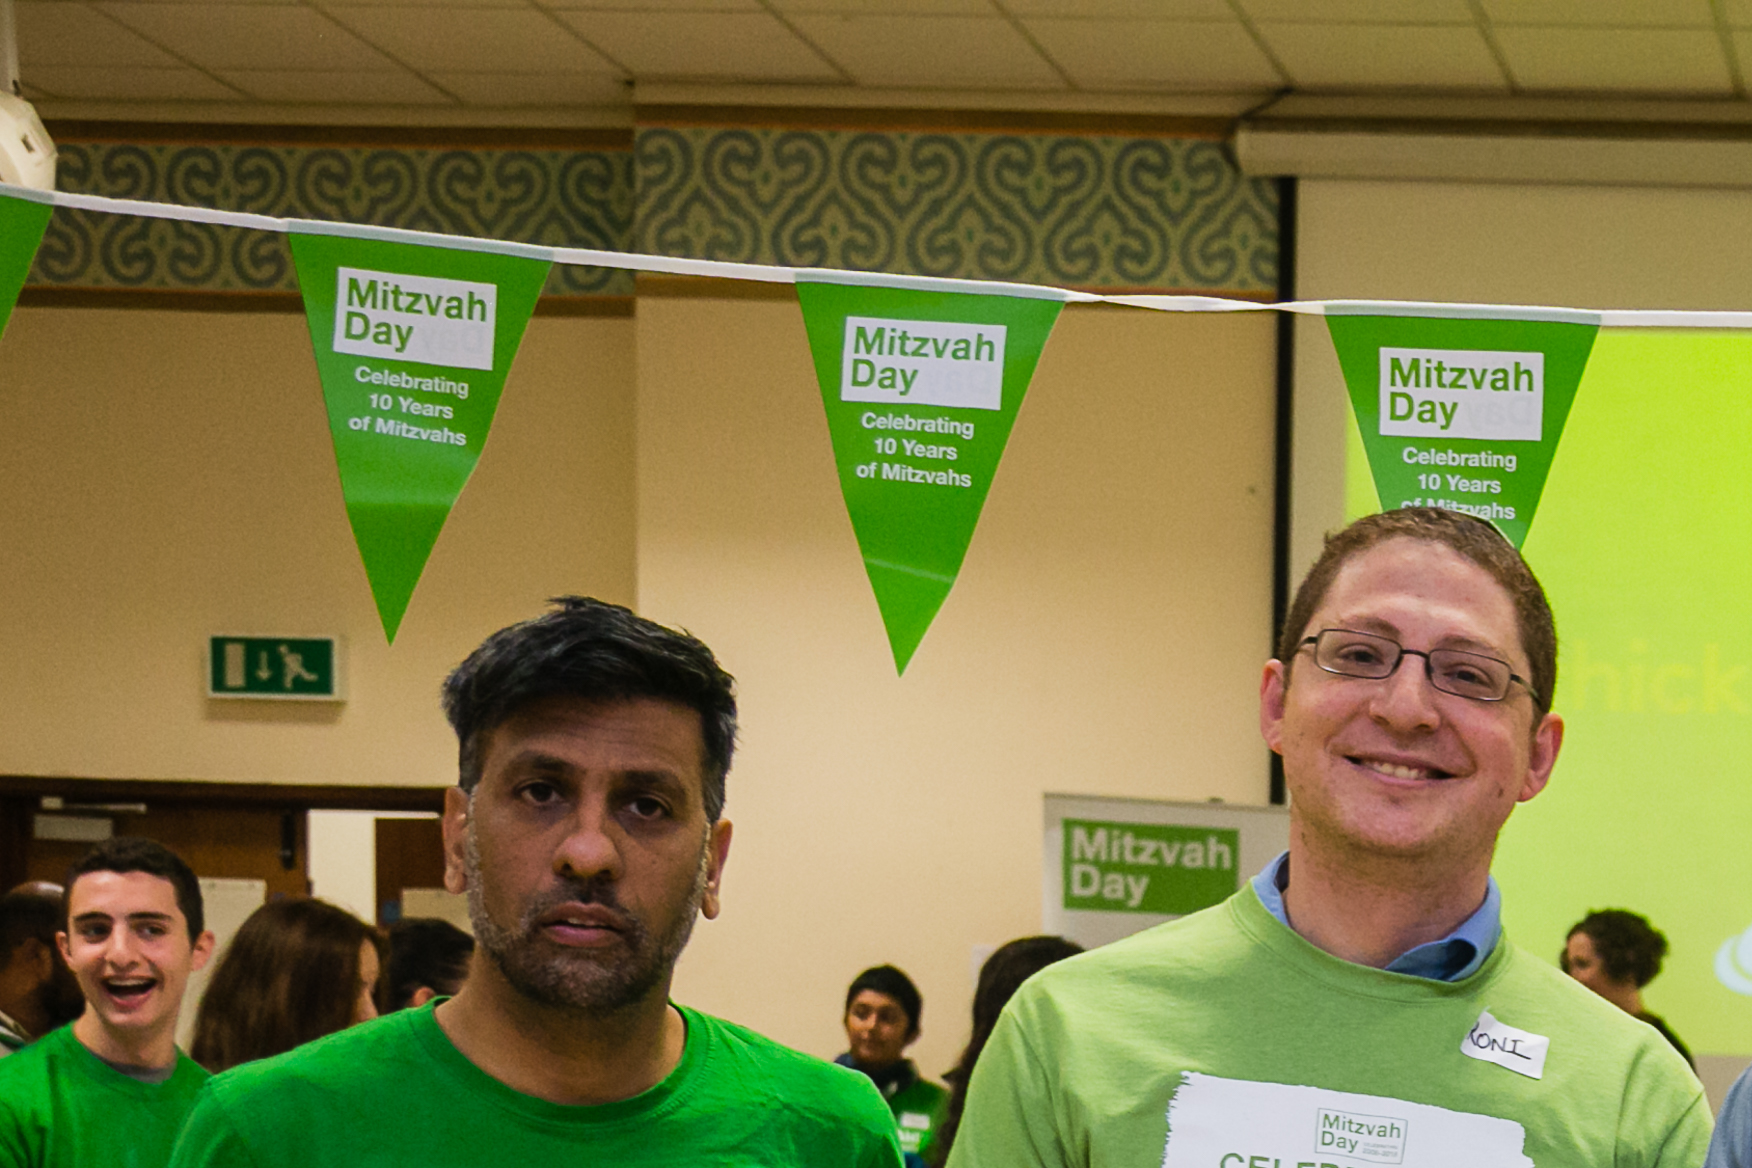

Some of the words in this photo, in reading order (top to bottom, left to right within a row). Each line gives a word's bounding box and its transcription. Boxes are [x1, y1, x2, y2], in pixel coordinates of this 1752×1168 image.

[347, 277, 487, 322] Mitzvah
[344, 311, 414, 353] Day
[853, 326, 995, 362] Mitzvah
[355, 365, 469, 400] Celebrating
[851, 358, 919, 396] Day
[1390, 357, 1534, 392] Mitzvah
[369, 393, 393, 410] 10
[399, 396, 454, 419] Years
[1389, 391, 1459, 430] Day
[348, 415, 372, 431] of
[375, 417, 467, 446] Mitzvahs
[861, 412, 974, 440] Celebrating
[874, 437, 897, 455] 10
[902, 438, 958, 461] Years
[1402, 446, 1517, 472] Celebrating
[856, 462, 878, 478] of
[881, 462, 972, 488] Mitzvahs
[1417, 473, 1441, 490] 10
[1446, 474, 1502, 493] Years
[1072, 826, 1231, 870] Mitzvah
[1071, 864, 1149, 908] Day
[1321, 1131, 1359, 1153] Day
[1322, 1113, 1401, 1138] Mitzvah
